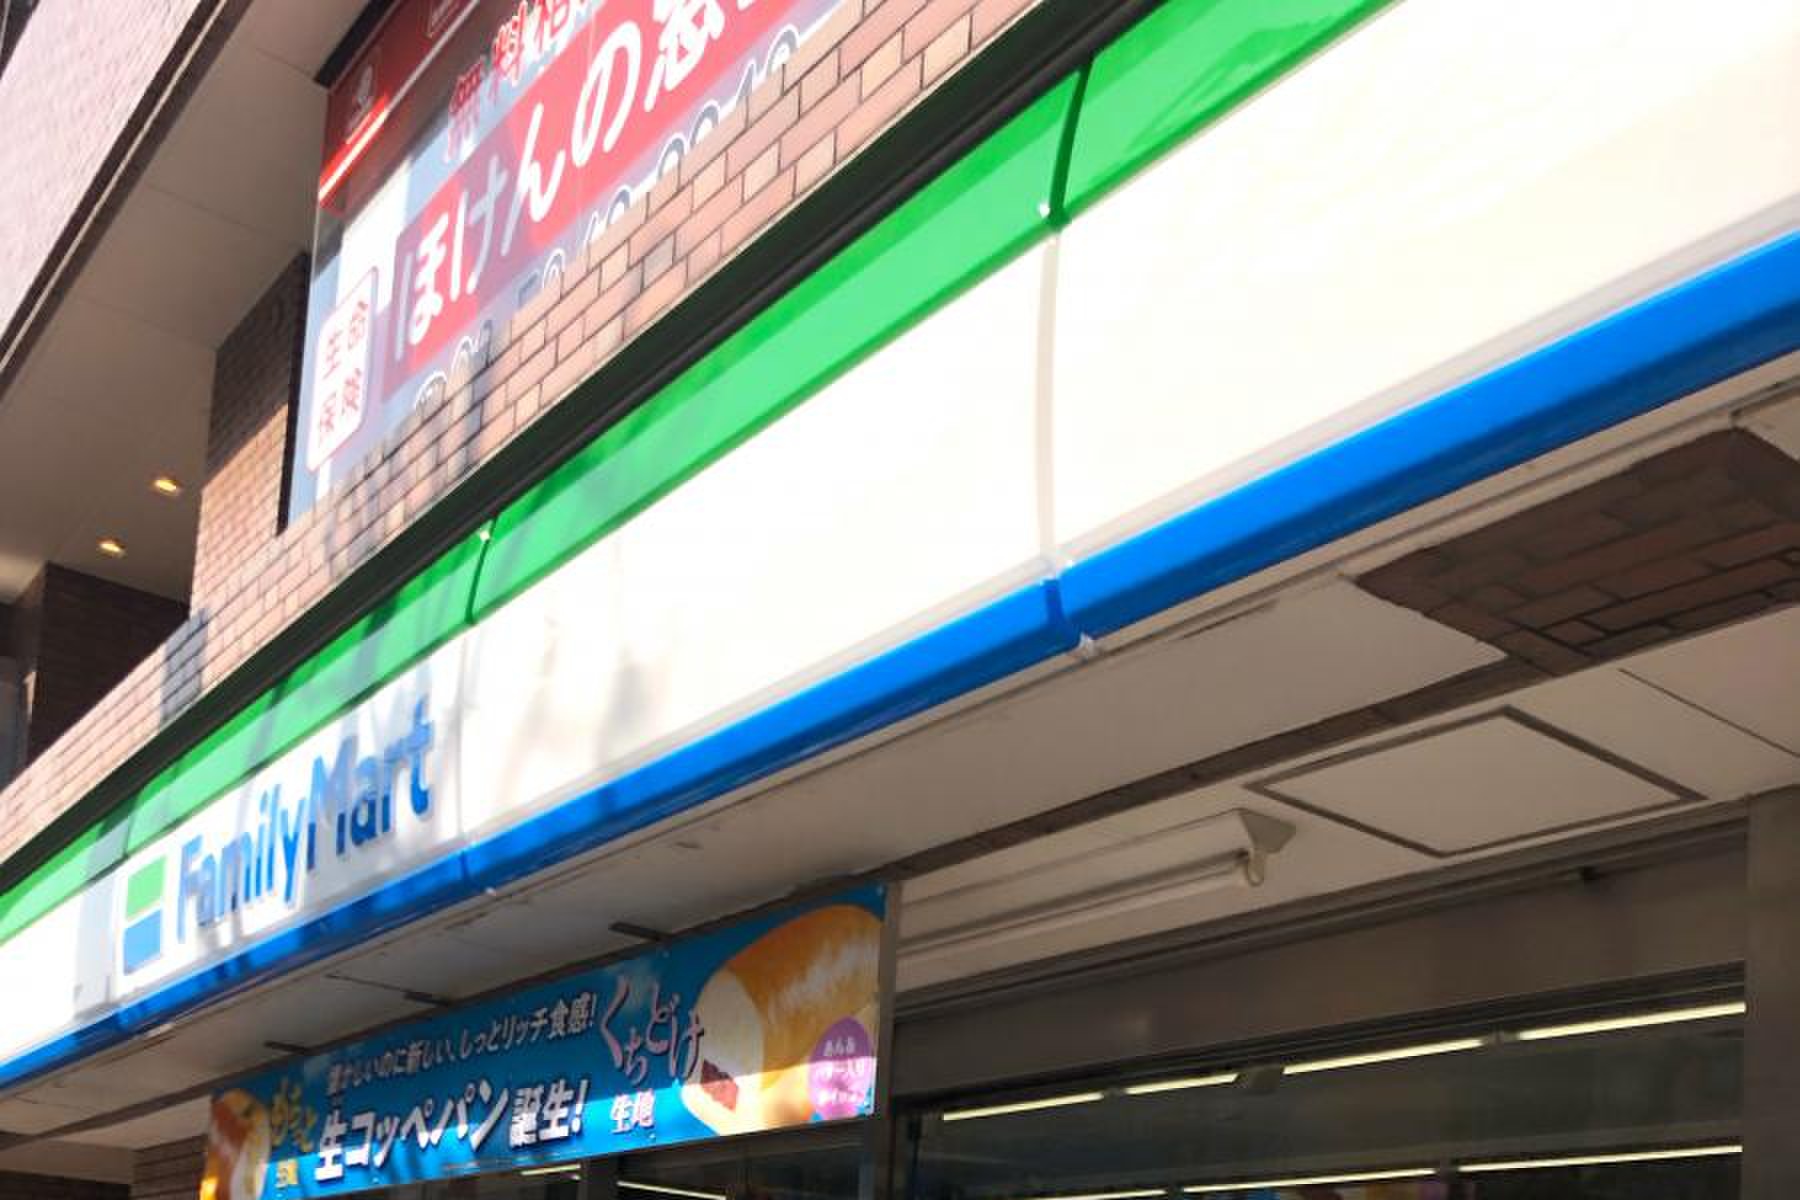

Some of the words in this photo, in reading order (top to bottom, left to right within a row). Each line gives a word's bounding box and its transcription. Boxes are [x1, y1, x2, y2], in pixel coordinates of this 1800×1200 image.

[394, 0, 752, 362] ほけんの窓
[177, 694, 437, 944] FamilyMart
